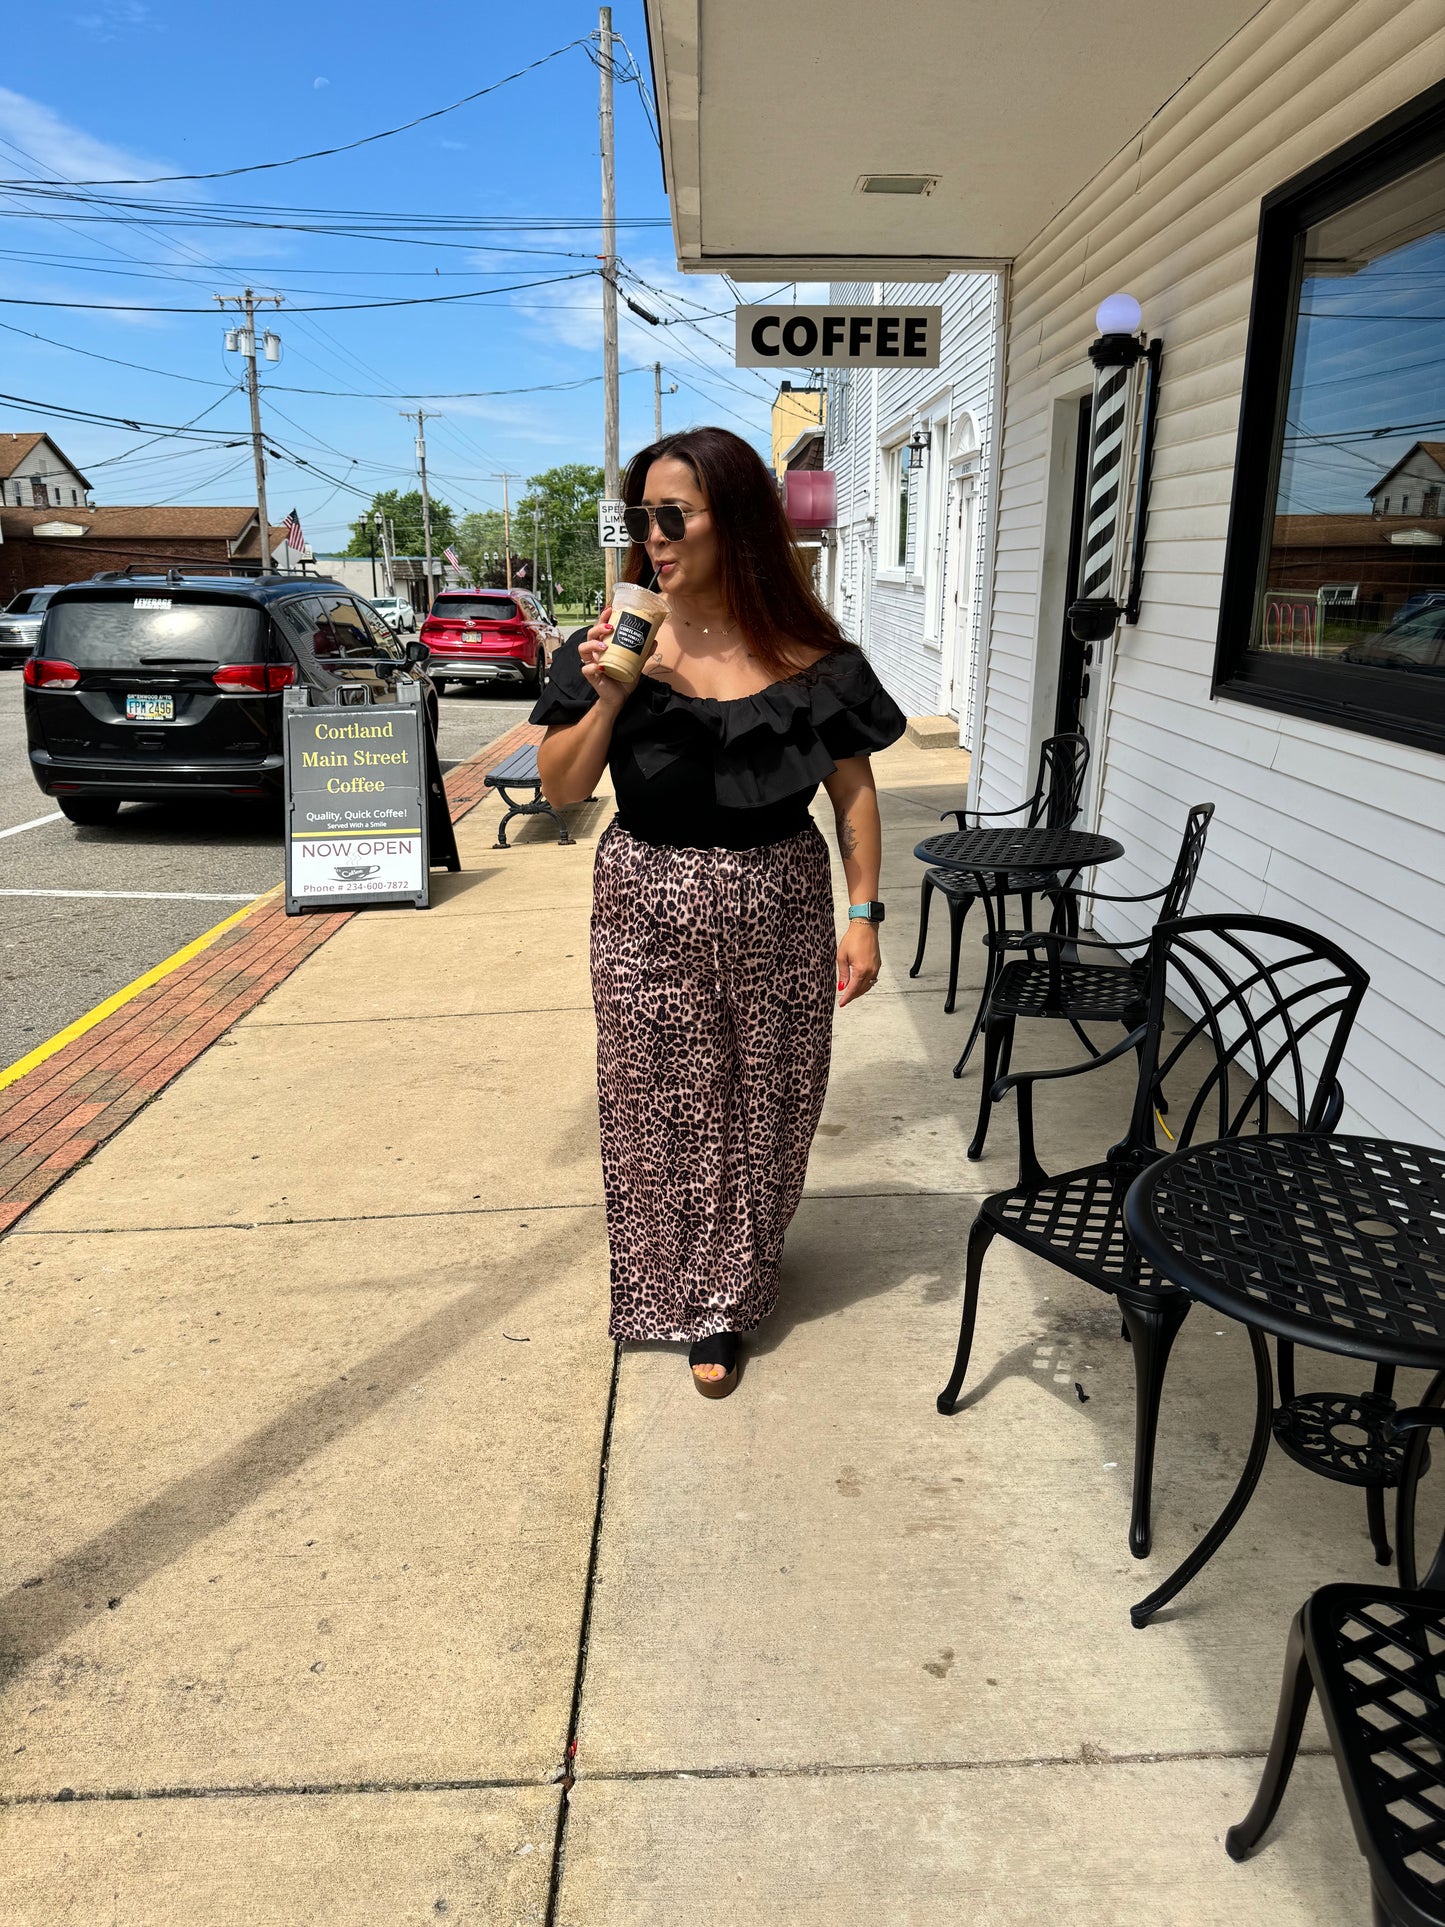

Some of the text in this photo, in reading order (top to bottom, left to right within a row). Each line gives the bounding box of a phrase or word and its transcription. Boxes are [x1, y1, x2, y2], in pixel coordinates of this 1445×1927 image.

[751, 315, 928, 357] COFFEE
[601, 505, 625, 514] SPEE
[605, 515, 623, 523] LIM
[603, 525, 630, 542] 25
[149, 701, 171, 714] 2496
[315, 721, 394, 740] Cortland
[302, 749, 409, 768] Main Street
[326, 776, 385, 794] Coffee
[306, 808, 408, 822] Quality, Quick Coffee!
[302, 840, 412, 858] NOW OPEN
[303, 884, 335, 893] Phone
